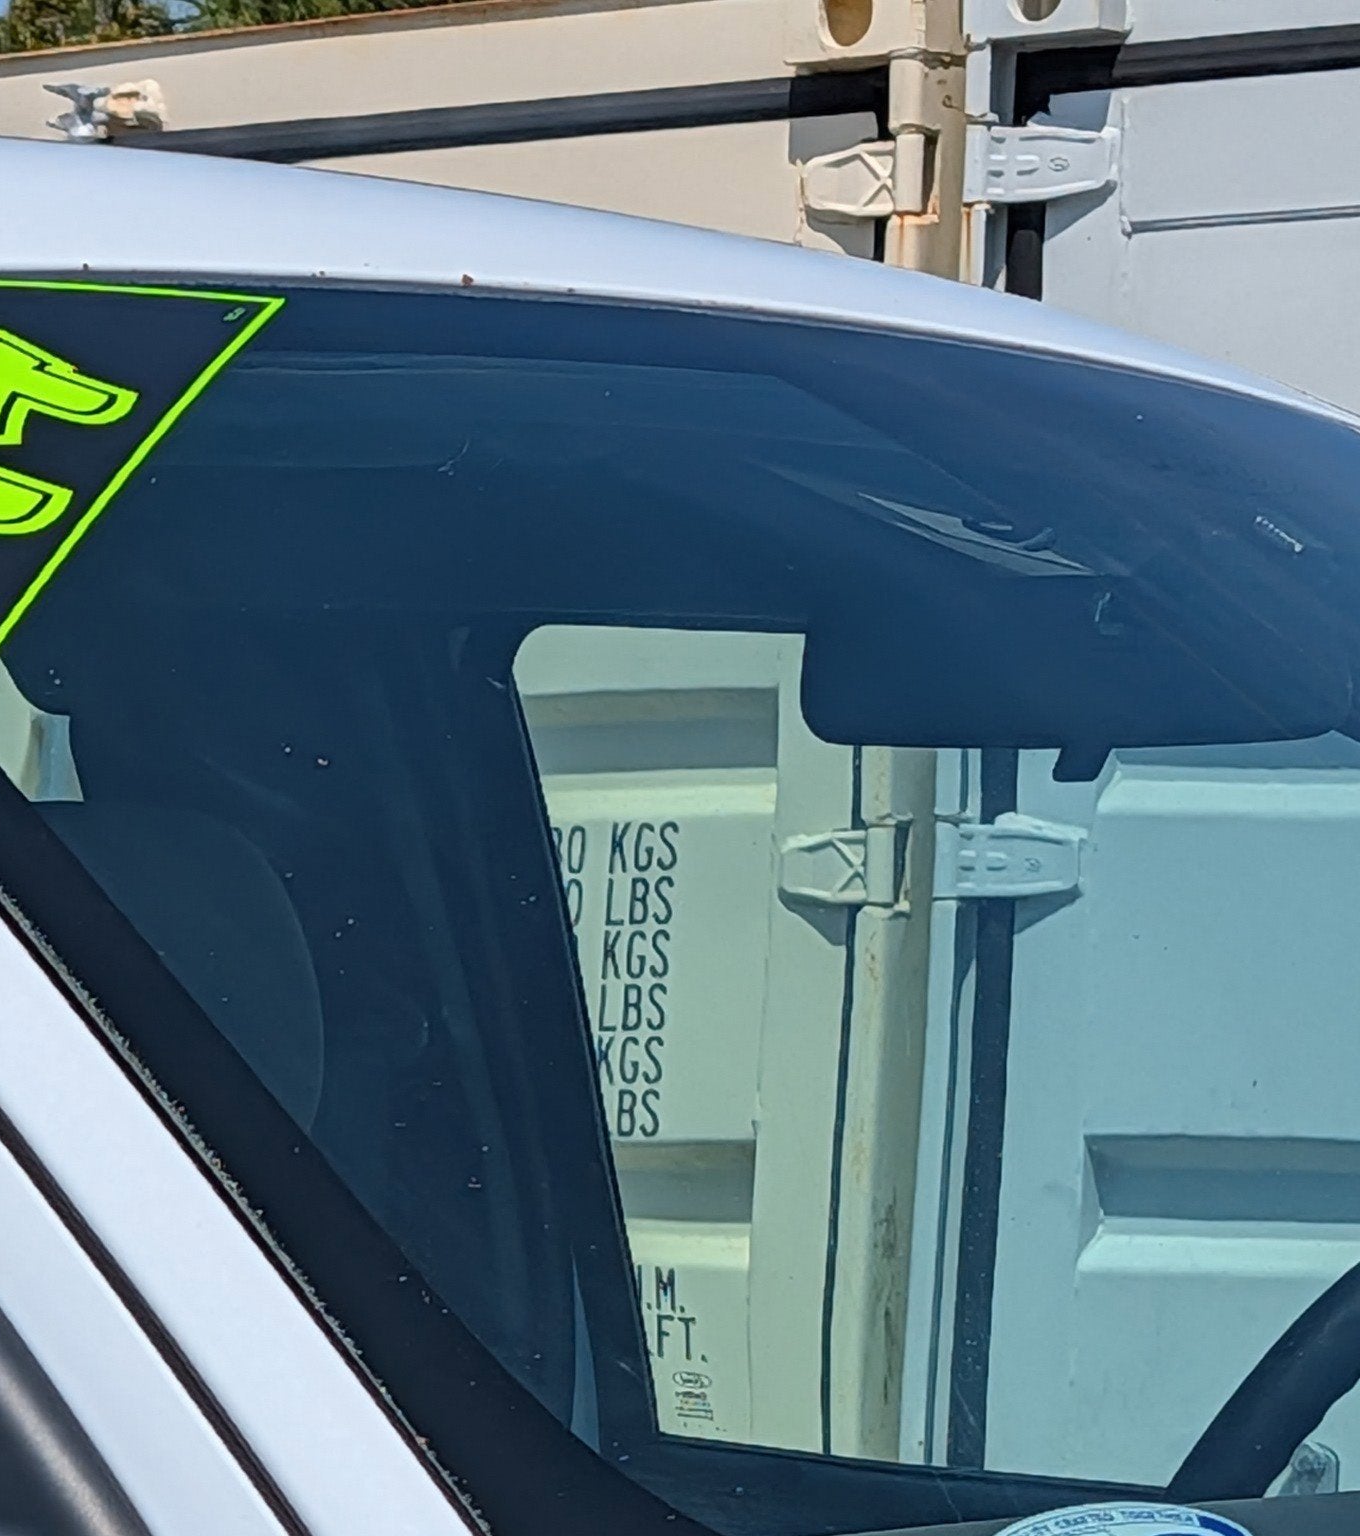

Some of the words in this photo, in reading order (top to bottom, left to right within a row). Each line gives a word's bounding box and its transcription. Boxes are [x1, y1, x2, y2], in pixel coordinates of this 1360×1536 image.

[609, 821, 679, 874] KGS
[605, 876, 675, 926] LBS
[601, 929, 671, 980] KGS
[598, 983, 668, 1032] LBS
[597, 1036, 665, 1085] KGS
[612, 1088, 660, 1137] BS
